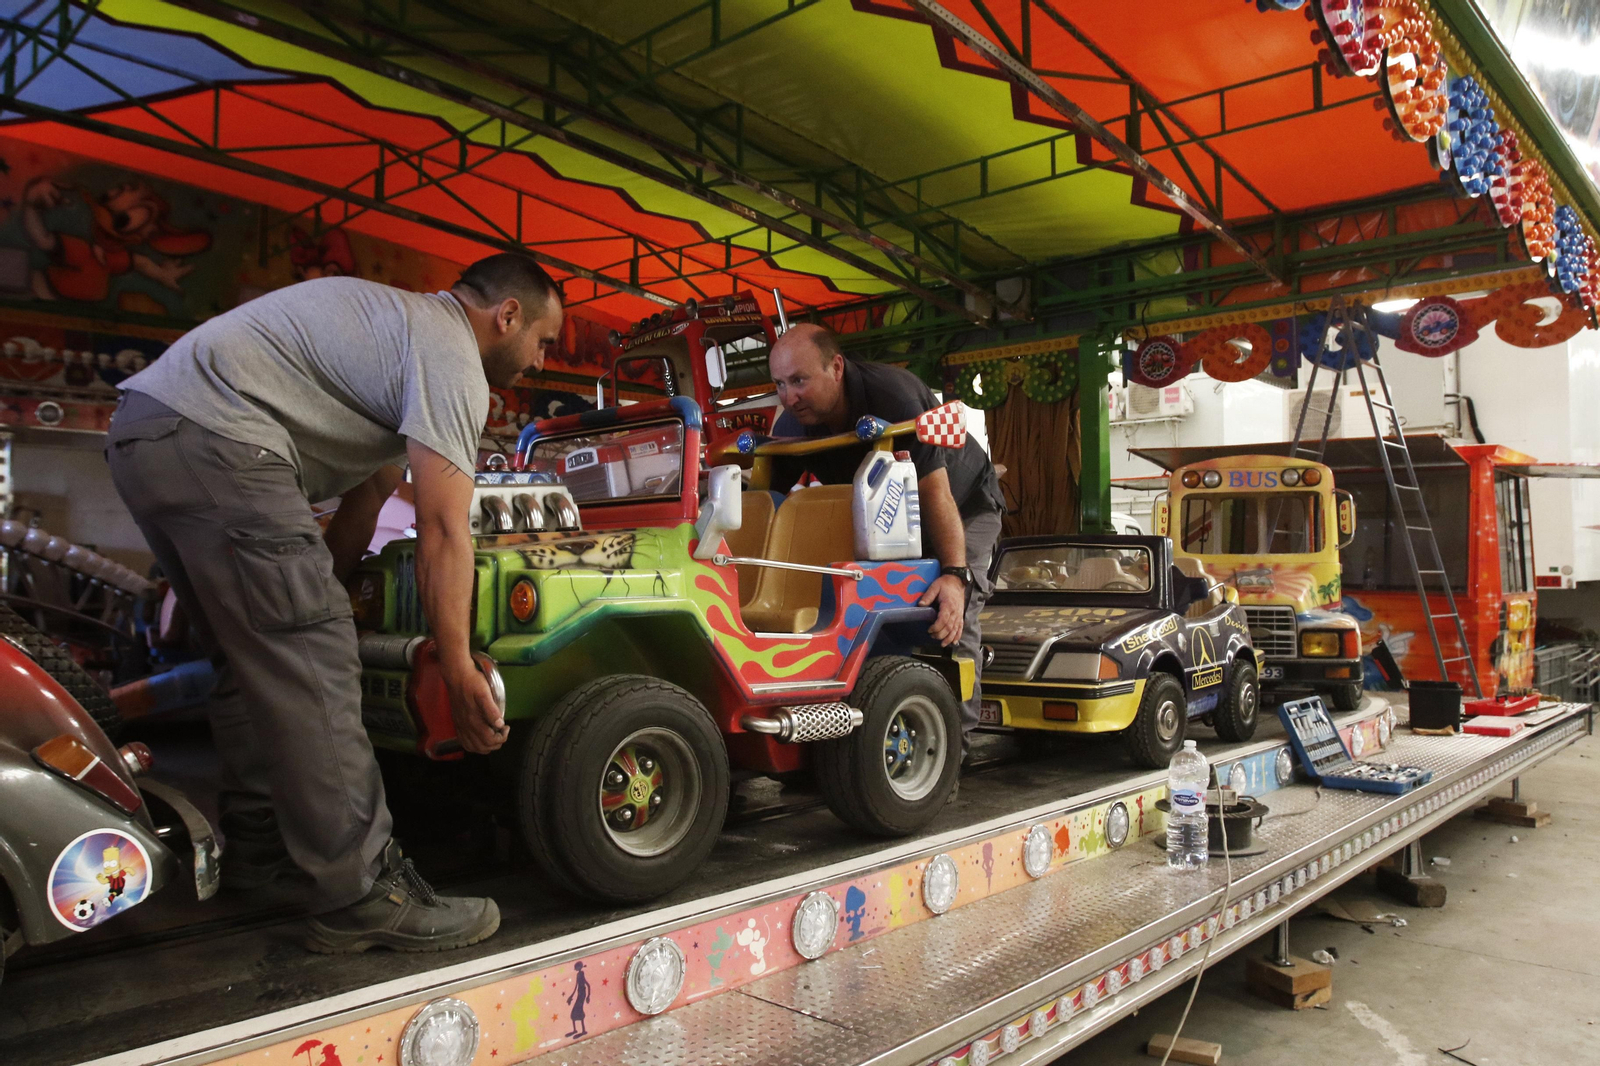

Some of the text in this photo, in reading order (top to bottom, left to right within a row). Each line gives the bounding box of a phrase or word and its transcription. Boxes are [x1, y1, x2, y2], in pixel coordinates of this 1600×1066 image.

[718, 302, 756, 317] CHMPION
[1229, 470, 1278, 488] BUS
[874, 479, 904, 534] PETROL
[1160, 506, 1169, 534] BUS
[1340, 503, 1348, 532] BUS
[1125, 620, 1175, 650] Shewood
[1193, 671, 1222, 688] Mercedes
